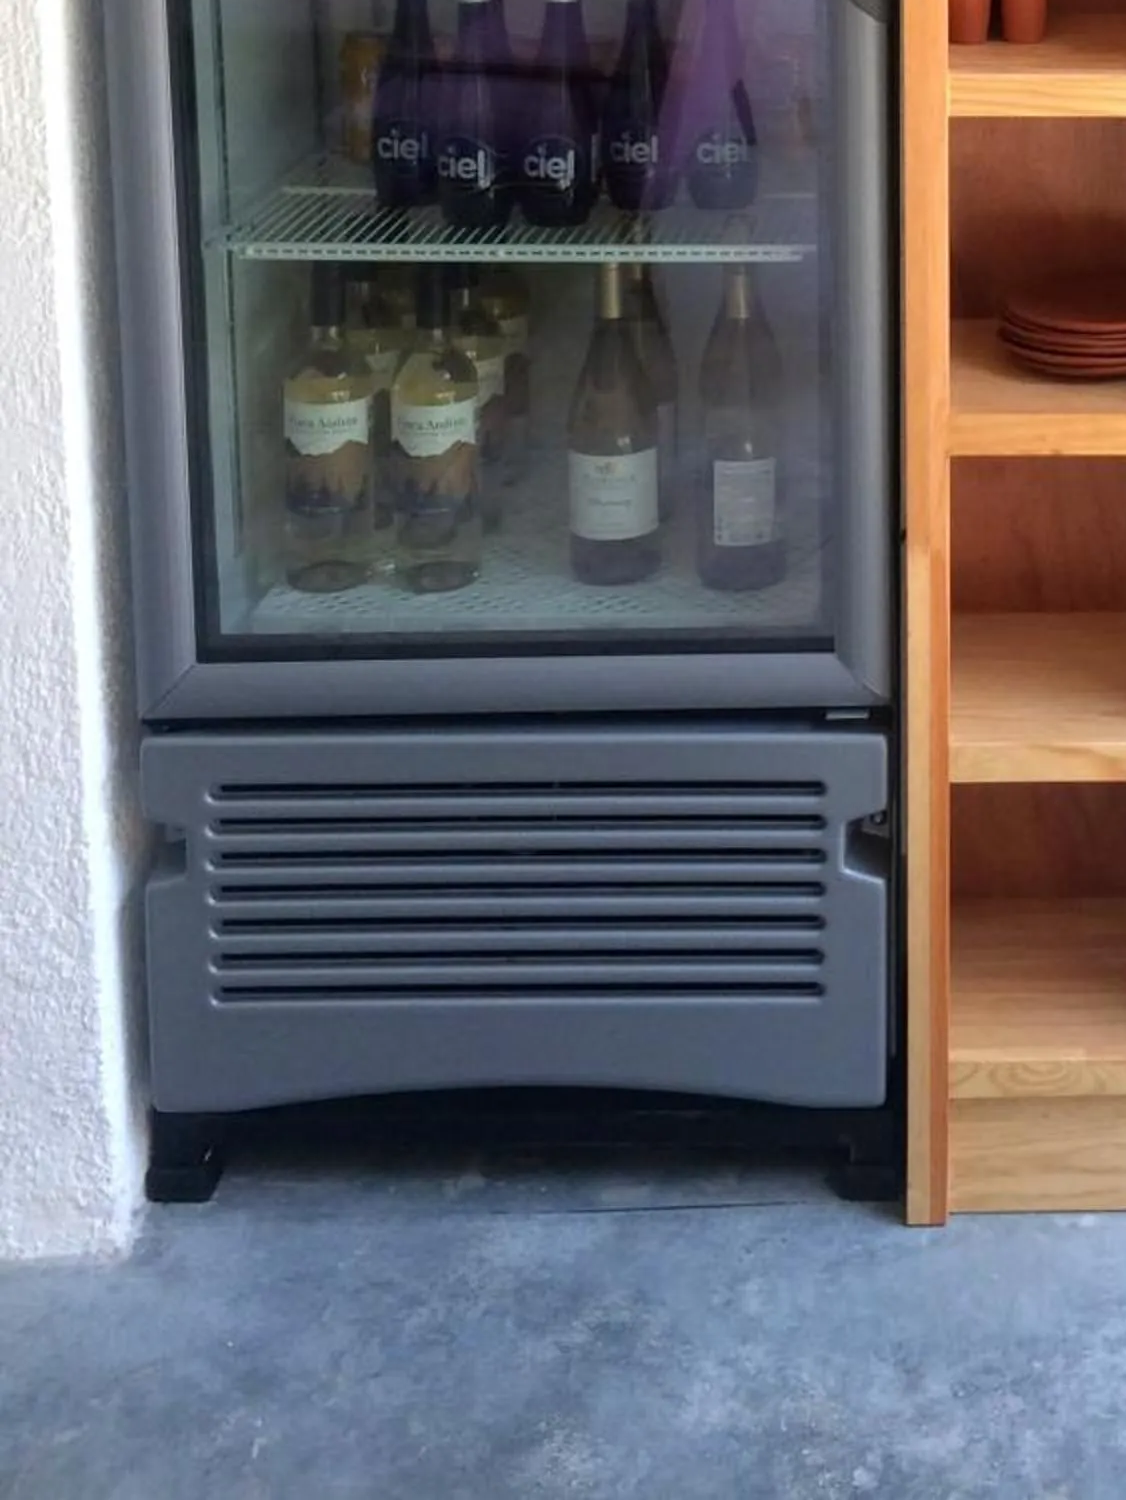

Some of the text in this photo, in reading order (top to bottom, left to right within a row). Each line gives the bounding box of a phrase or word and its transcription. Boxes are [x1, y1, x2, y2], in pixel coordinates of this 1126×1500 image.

[377, 128, 428, 160] ciel
[609, 132, 658, 164] ciel
[697, 133, 748, 164] ciel
[438, 146, 486, 179] ciel
[524, 143, 574, 179] ciel
